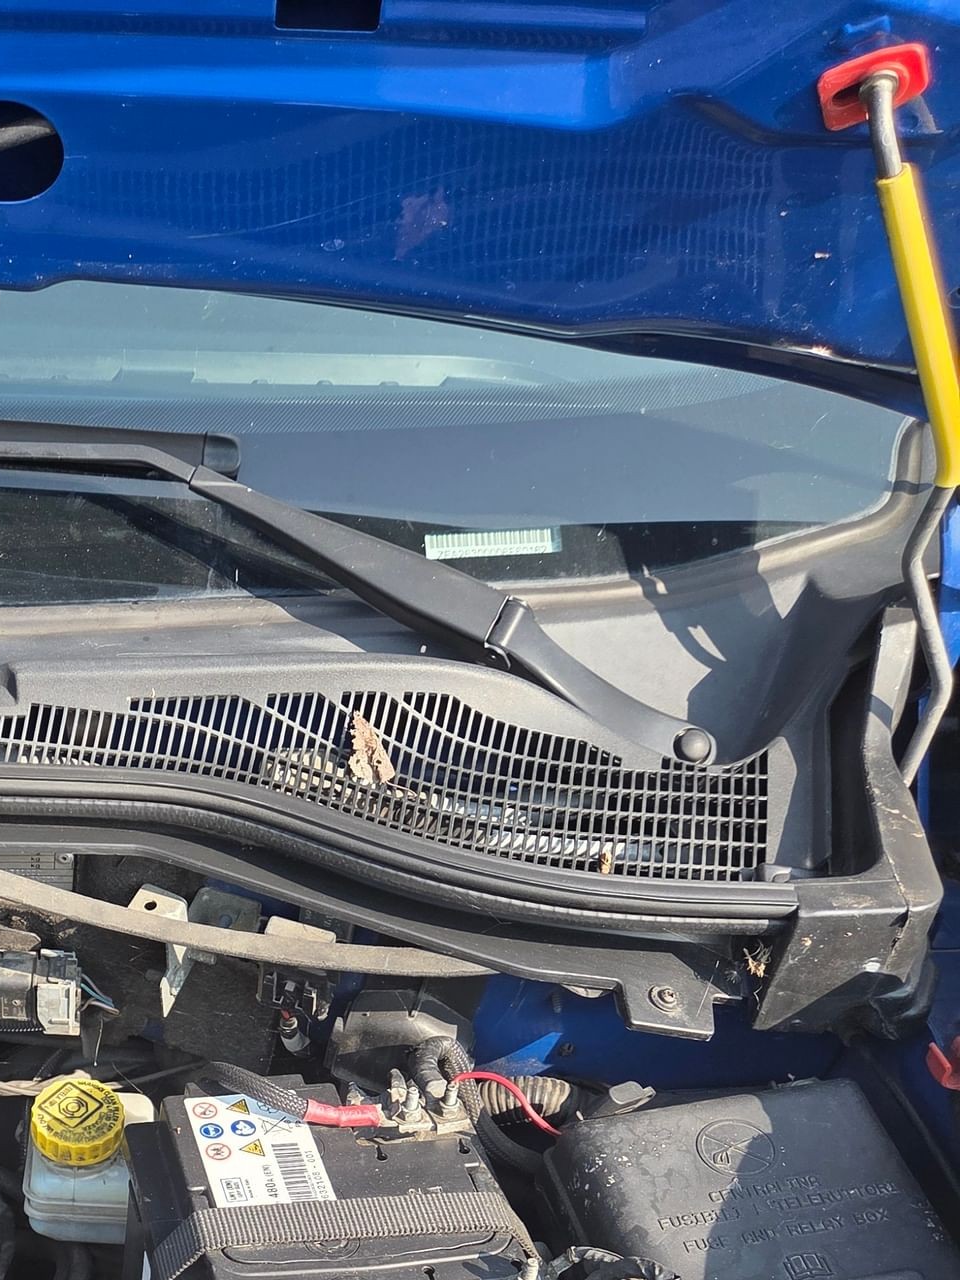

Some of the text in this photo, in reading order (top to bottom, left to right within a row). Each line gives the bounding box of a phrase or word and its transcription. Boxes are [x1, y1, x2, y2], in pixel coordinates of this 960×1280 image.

[683, 1207, 890, 1254] FUSE AND RELAY BOX
